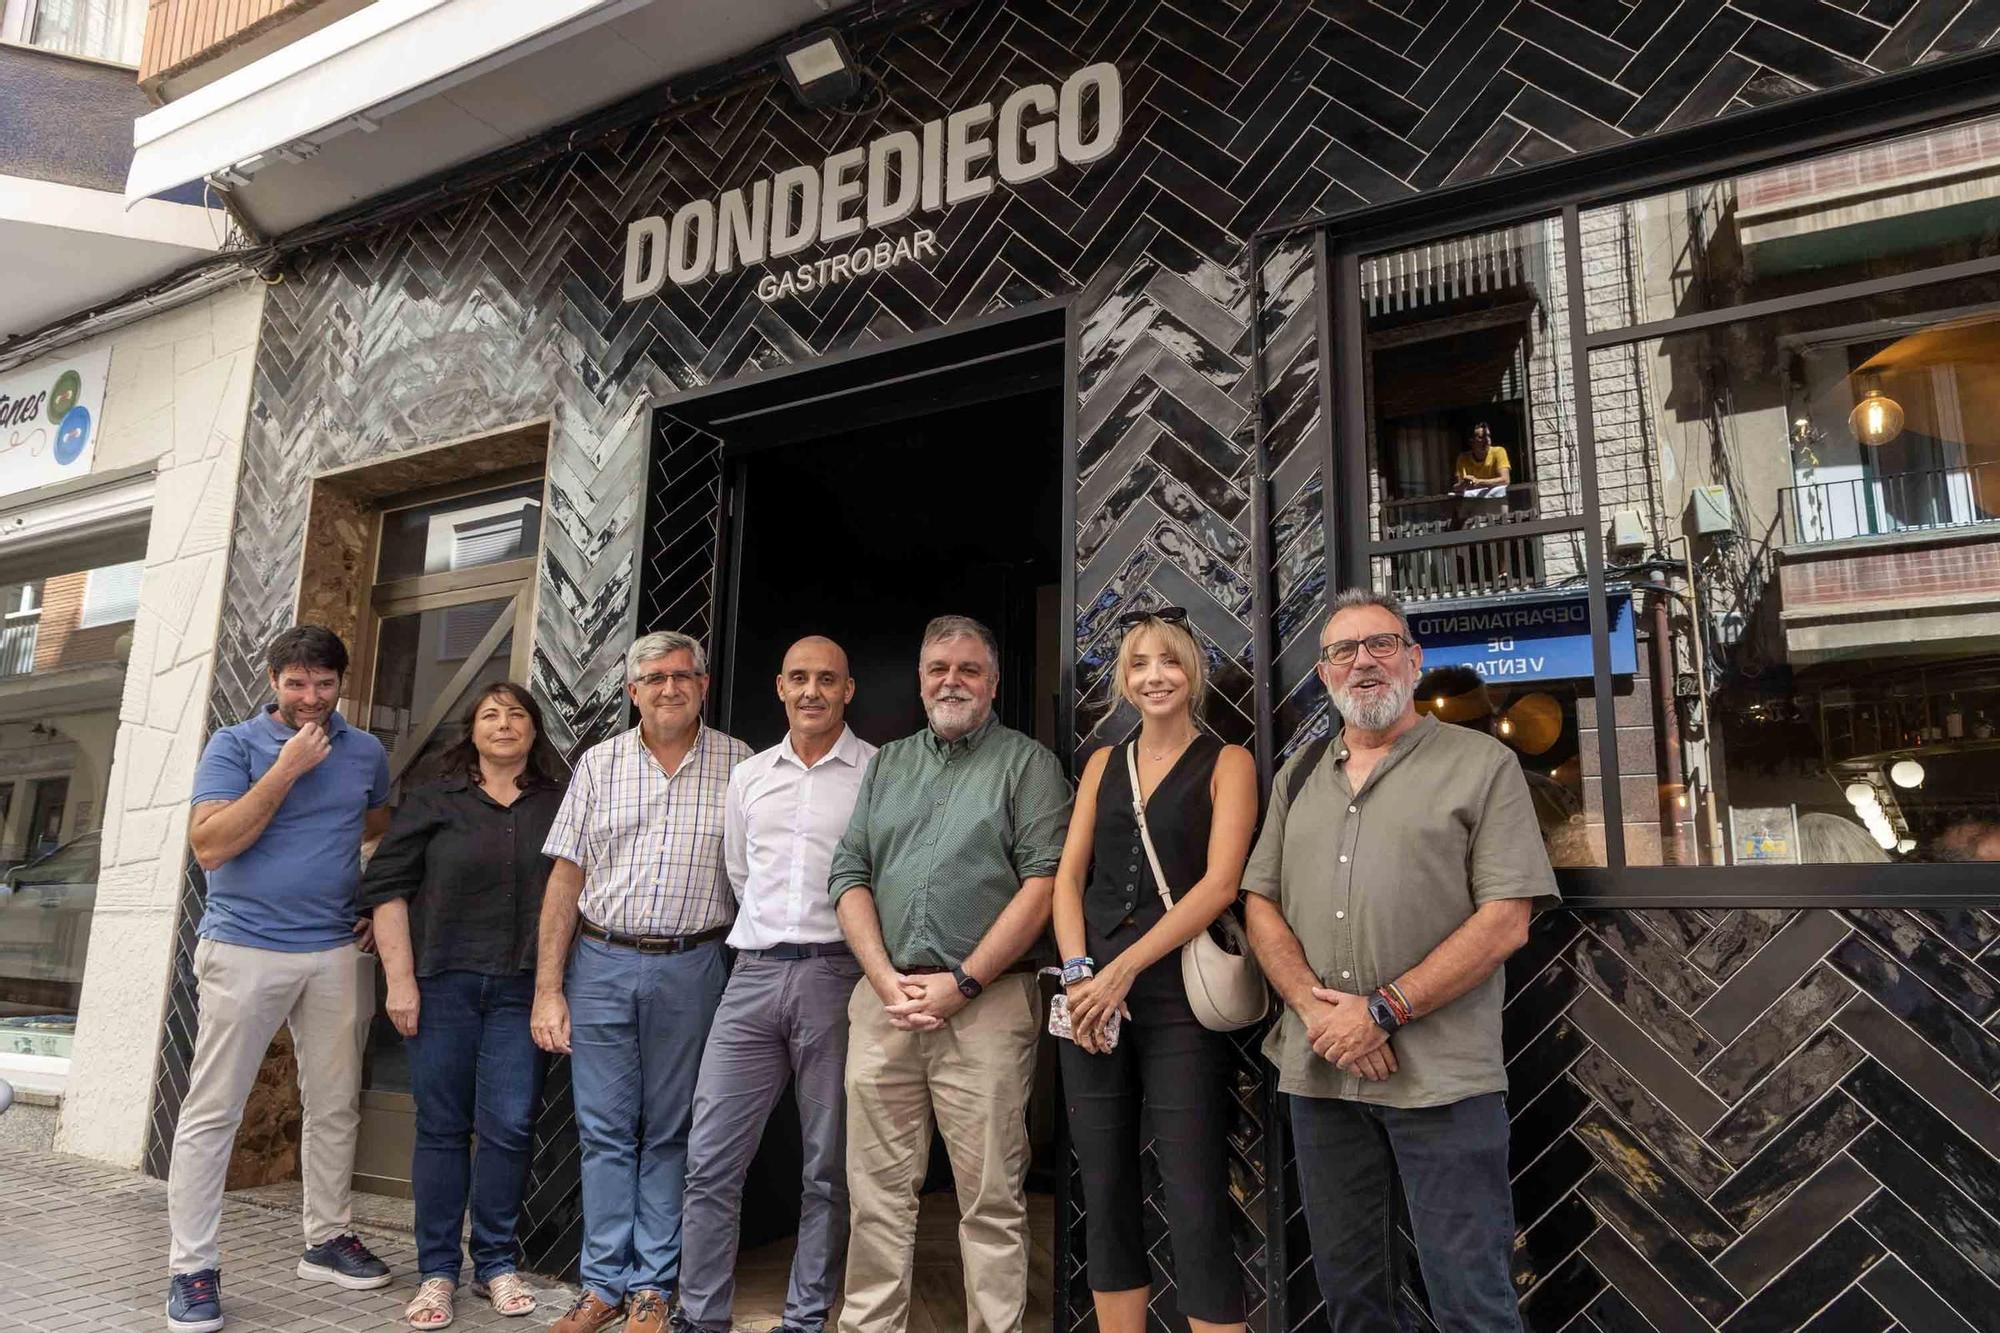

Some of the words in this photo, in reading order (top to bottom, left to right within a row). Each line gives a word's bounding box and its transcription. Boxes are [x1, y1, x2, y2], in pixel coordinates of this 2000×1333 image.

[622, 62, 1123, 302] DONDEDIEGO
[757, 229, 937, 302] GASTROBAR
[0, 390, 47, 428] ones
